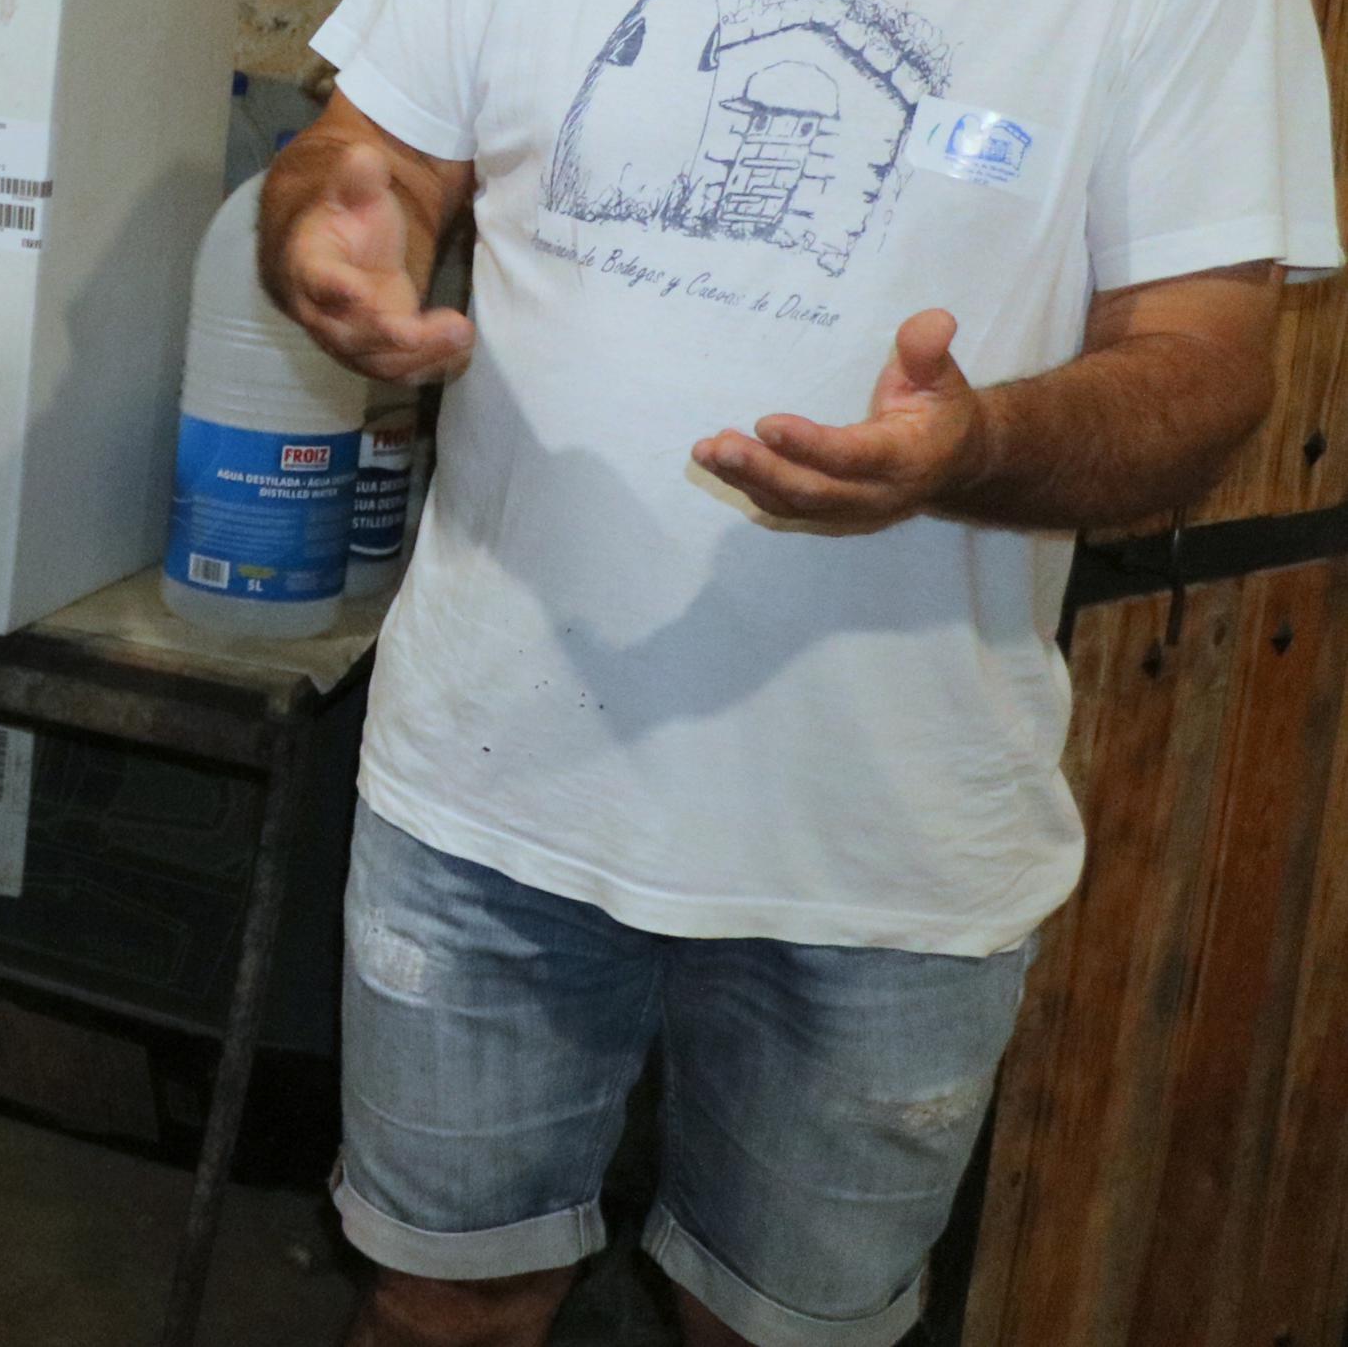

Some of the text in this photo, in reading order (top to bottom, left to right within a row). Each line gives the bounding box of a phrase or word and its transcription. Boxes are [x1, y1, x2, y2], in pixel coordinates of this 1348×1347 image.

[601, 248, 663, 287] Bodegas
[659, 275, 681, 297] y
[686, 272, 745, 306] Cuevas
[749, 292, 769, 313] de
[775, 294, 841, 327] Dueñas
[283, 447, 328, 463] FROIZ
[217, 469, 245, 482] AGUA
[245, 474, 301, 487] DESTILADA
[258, 487, 311, 500] DISTILLED
[247, 579, 264, 592] 5L
